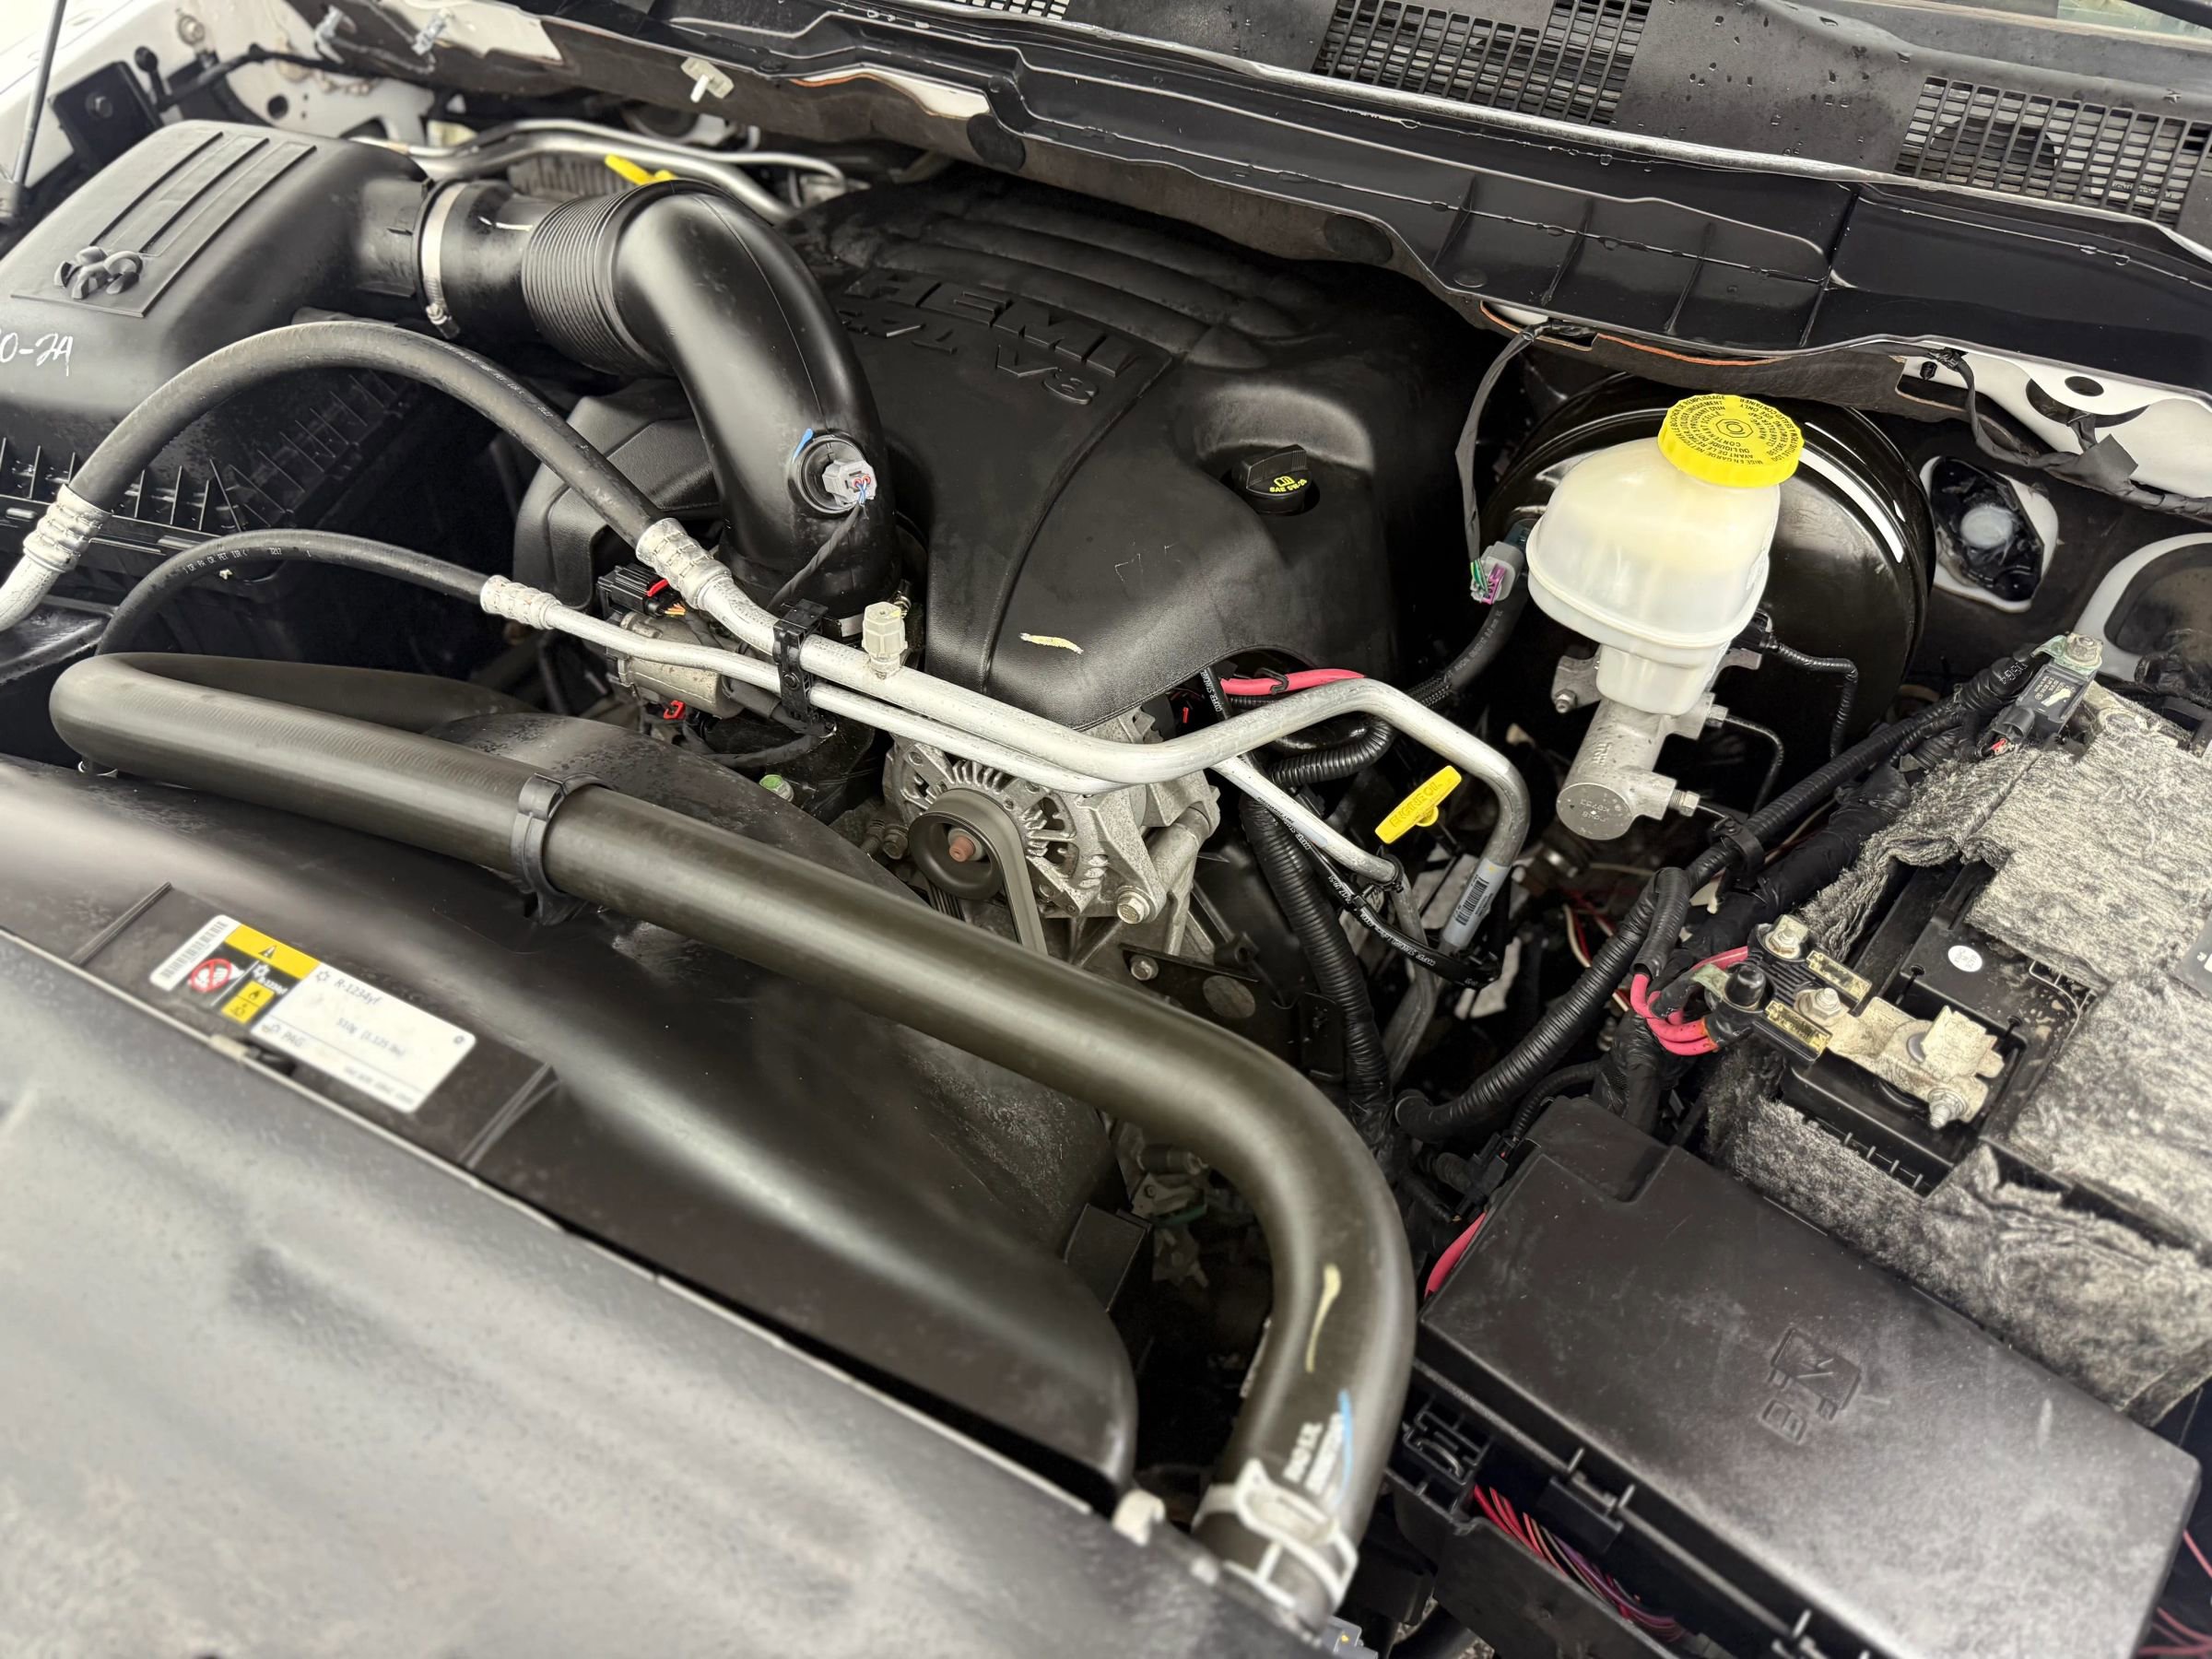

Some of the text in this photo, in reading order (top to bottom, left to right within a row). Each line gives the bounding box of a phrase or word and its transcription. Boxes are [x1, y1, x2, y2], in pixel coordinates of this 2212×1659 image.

[842, 268, 1135, 379] HEMI
[994, 342, 1100, 406] V8
[1209, 694, 1223, 712] COOPER
[1389, 782, 1442, 827] ENGINE OIL
[1295, 832, 1311, 851] COOPER
[1391, 940, 1418, 959] STANDARD
[1415, 953, 1436, 967] COOPER
[333, 978, 382, 1006] R-1234yf
[280, 1031, 304, 1049] PAG
